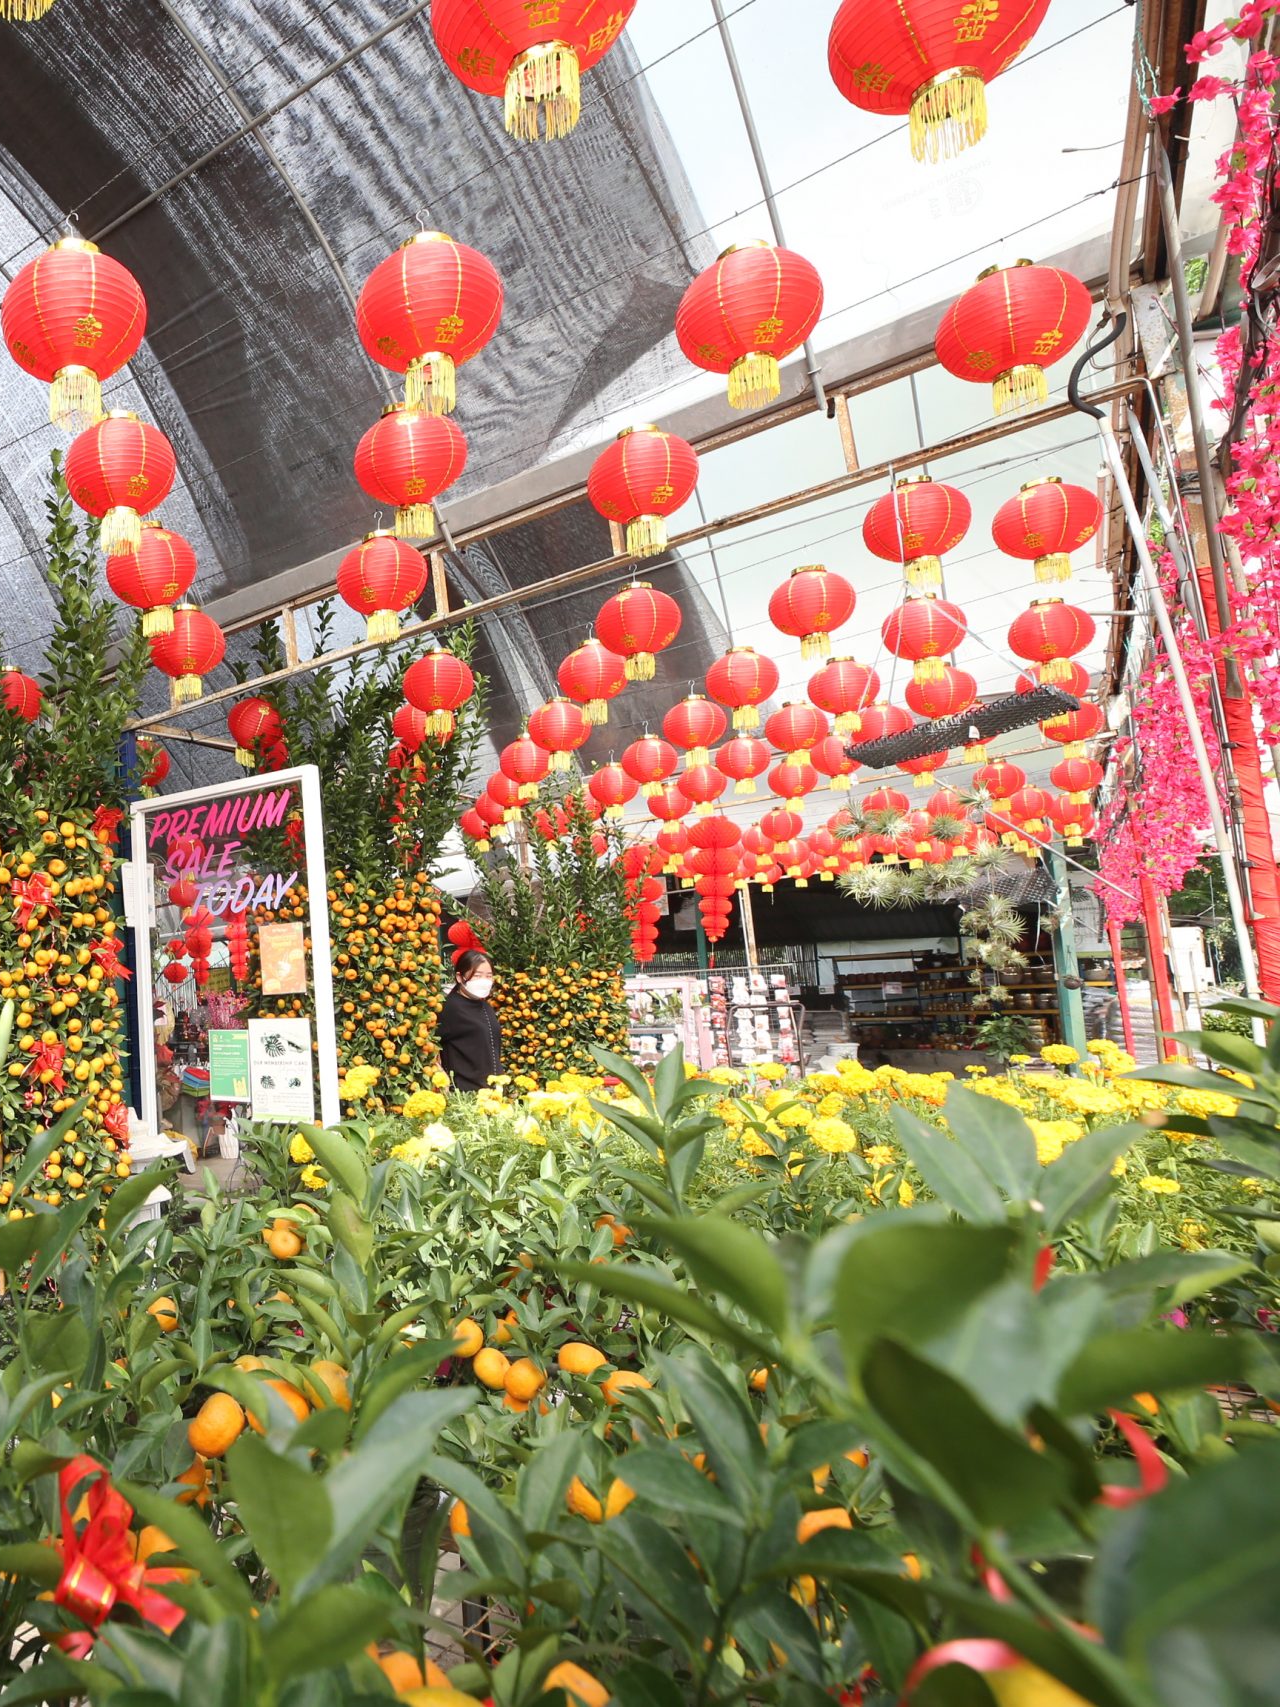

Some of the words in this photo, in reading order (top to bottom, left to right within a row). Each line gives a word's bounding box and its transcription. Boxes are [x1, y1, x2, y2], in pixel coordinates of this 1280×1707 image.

[148, 788, 291, 848] PREMIUM
[162, 841, 242, 884] SALE
[190, 870, 298, 917] TODAY
